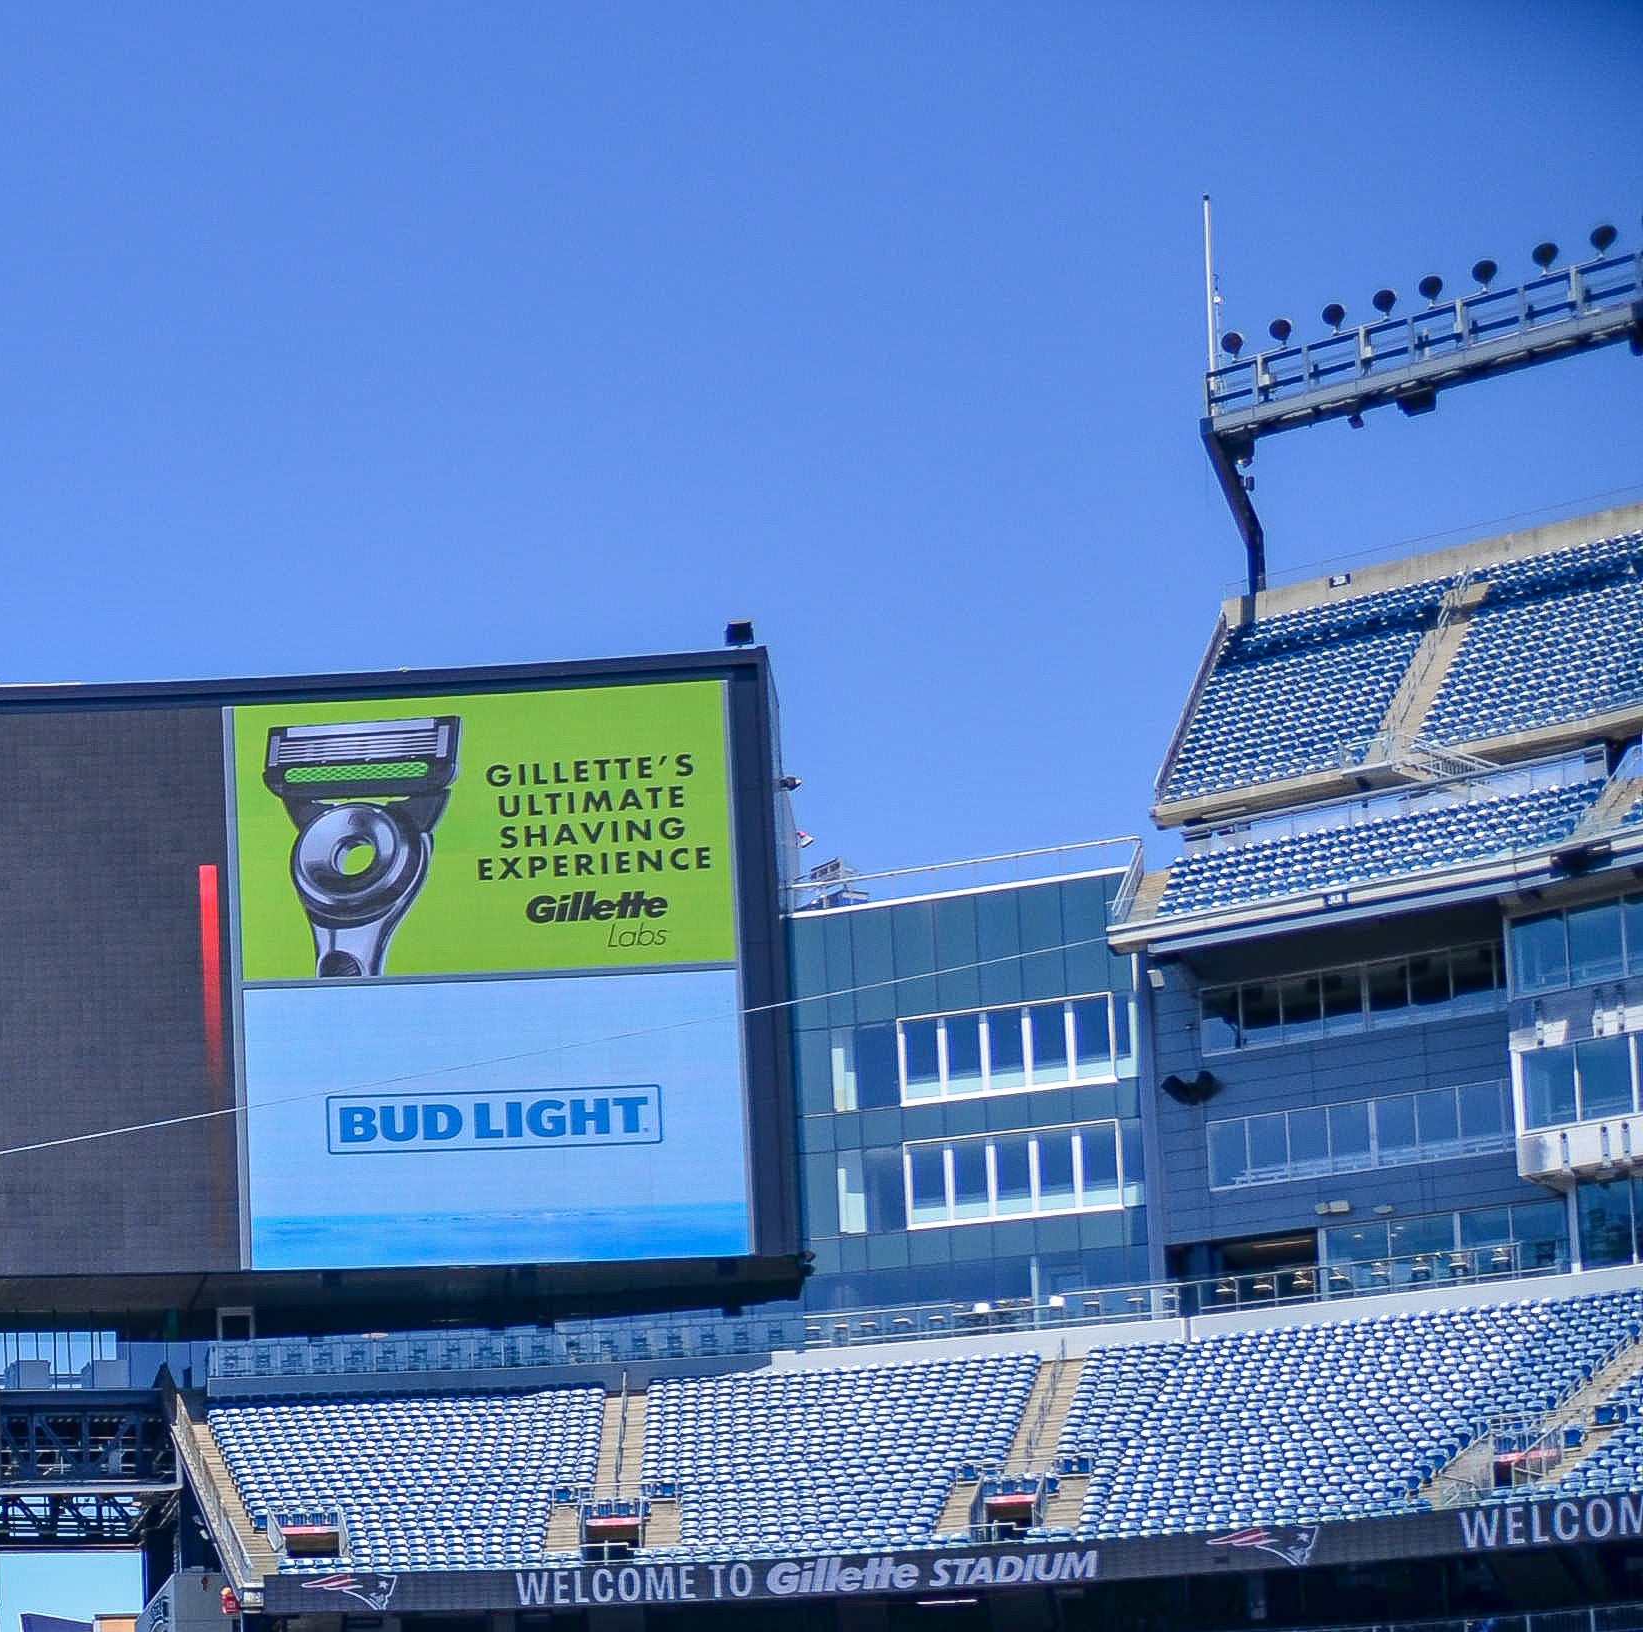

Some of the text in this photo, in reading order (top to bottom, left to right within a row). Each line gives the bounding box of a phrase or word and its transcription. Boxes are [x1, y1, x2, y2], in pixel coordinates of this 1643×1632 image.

[485, 752, 695, 788] GILLETTE'S
[498, 785, 686, 818] ULTIMATE
[499, 816, 685, 850] SHAVING
[476, 846, 712, 882] EXPERIENCE
[525, 890, 668, 925] Gillette
[607, 925, 668, 949] Labs
[338, 1095, 649, 1144] BUD LIGHT
[515, 1549, 1099, 1606] WELCOME TO Gillette STADIUM
